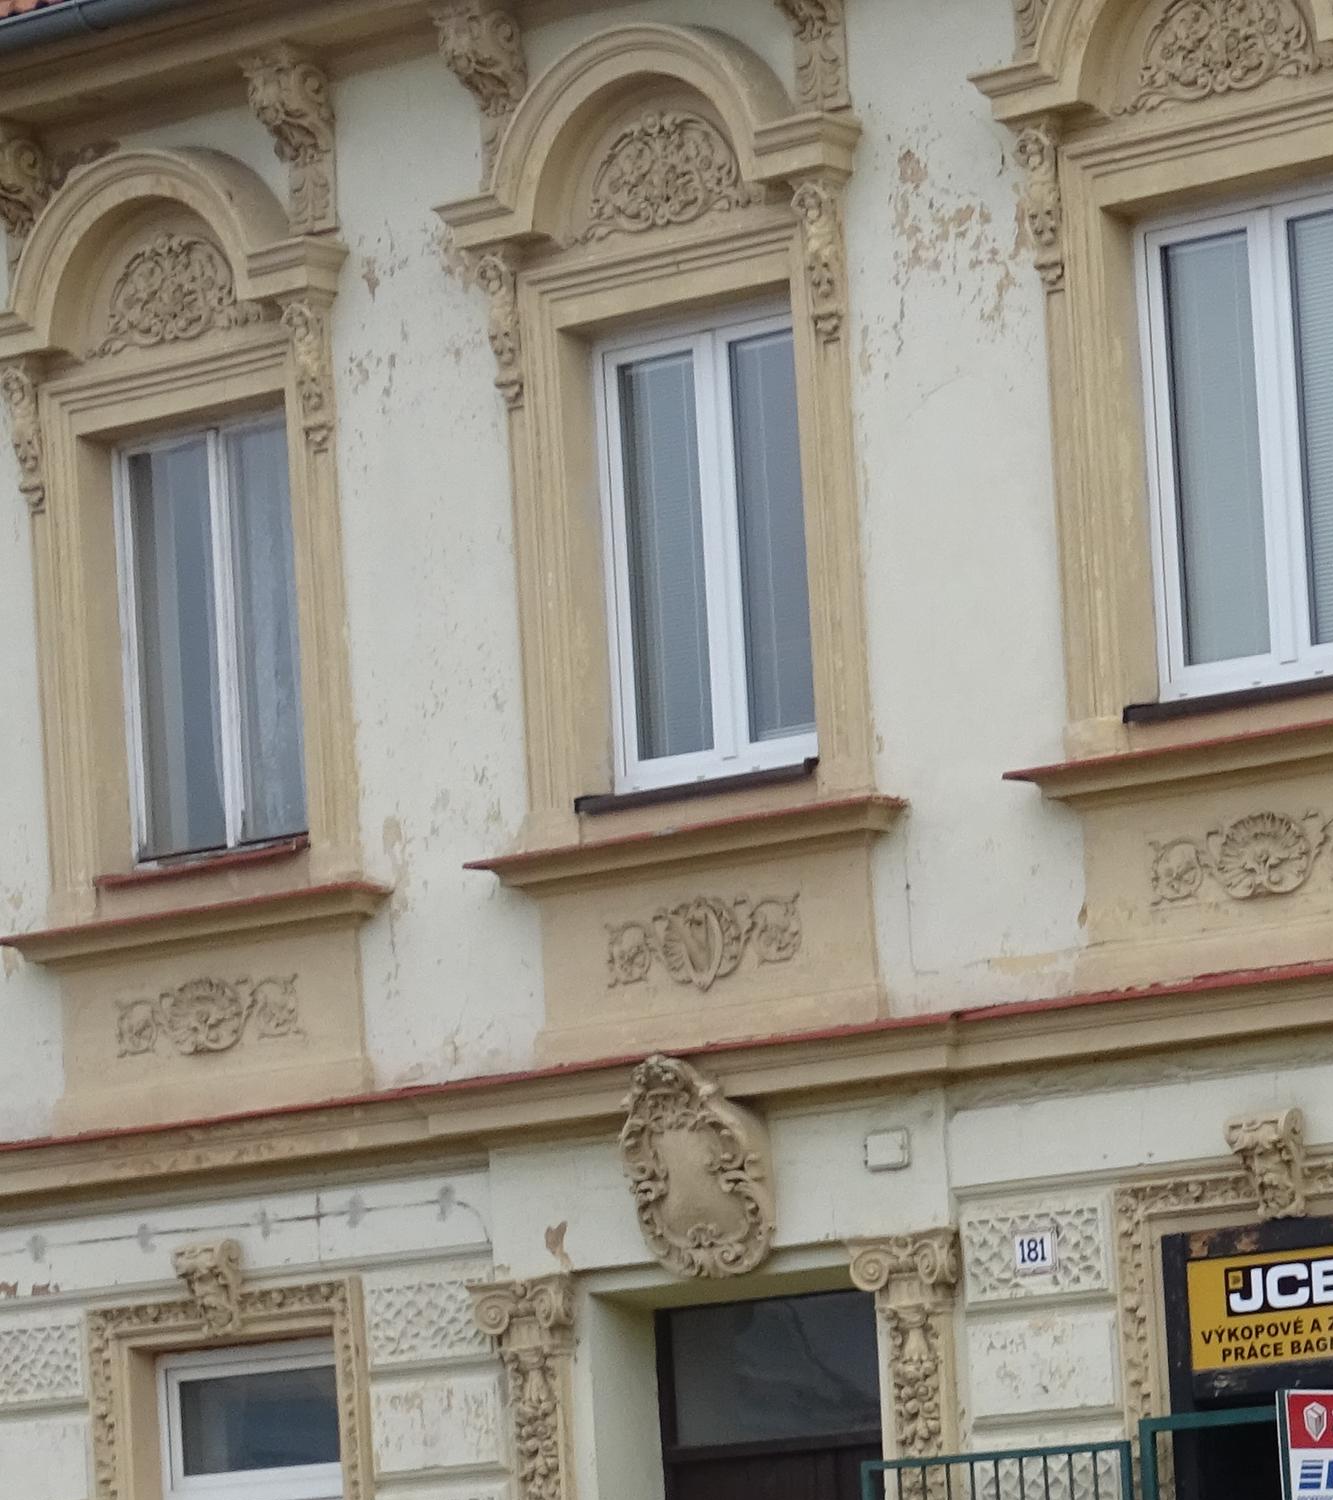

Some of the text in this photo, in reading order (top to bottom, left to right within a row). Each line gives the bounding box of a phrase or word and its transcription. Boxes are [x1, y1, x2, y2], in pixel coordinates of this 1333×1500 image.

[1018, 1236, 1046, 1263] 181
[1200, 1317, 1305, 1345] VÝKOPOVÉ
[1310, 1320, 1322, 1333] A
[1222, 1340, 1284, 1363] PRÁCE
